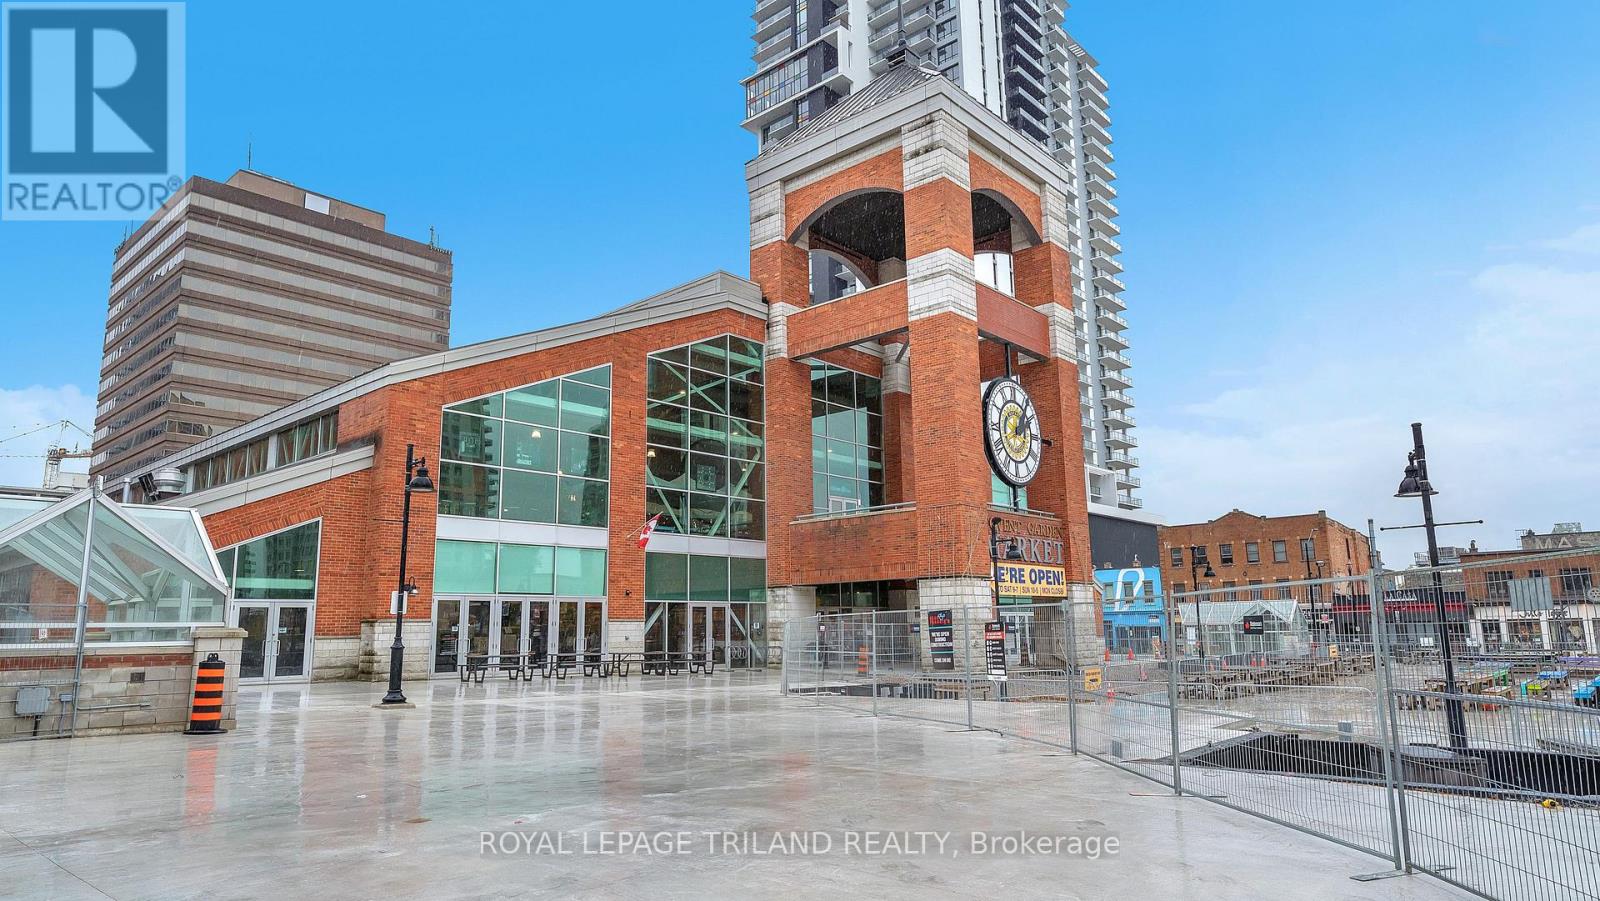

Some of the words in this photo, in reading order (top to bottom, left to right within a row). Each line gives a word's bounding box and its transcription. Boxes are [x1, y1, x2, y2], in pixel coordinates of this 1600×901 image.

[1027, 521, 1063, 539] GARDEN
[996, 567, 1026, 584] E'RE
[1029, 568, 1065, 586] OPEN!
